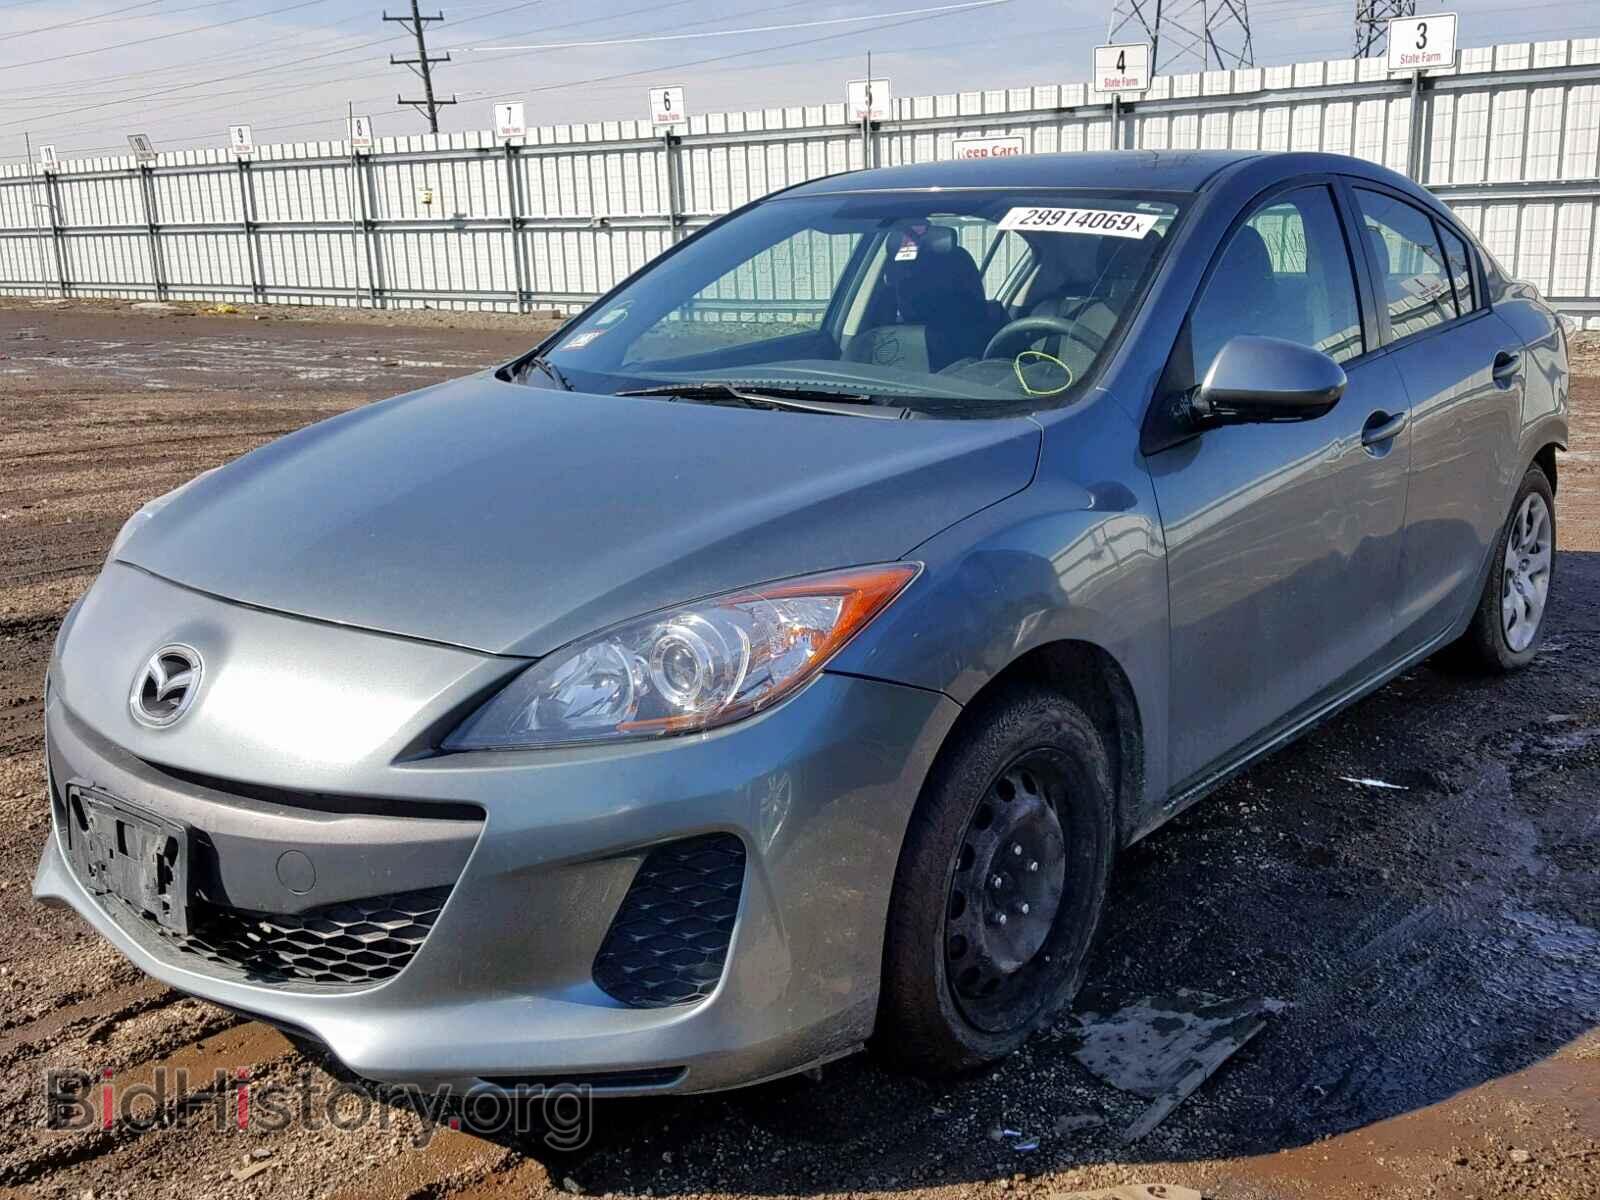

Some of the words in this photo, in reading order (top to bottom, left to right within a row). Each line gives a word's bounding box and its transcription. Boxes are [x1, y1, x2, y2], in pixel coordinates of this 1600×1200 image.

[1416, 22, 1427, 49] 3
[1116, 50, 1126, 74] 4
[1400, 53, 1420, 64] State
[1421, 52, 1440, 62] Farm
[1104, 78, 1120, 87] State
[1122, 77, 1137, 86] Farm
[664, 91, 671, 111] 6
[865, 85, 872, 106] 5
[506, 106, 511, 124] 7
[237, 128, 243, 143] 9
[357, 120, 362, 136] 8
